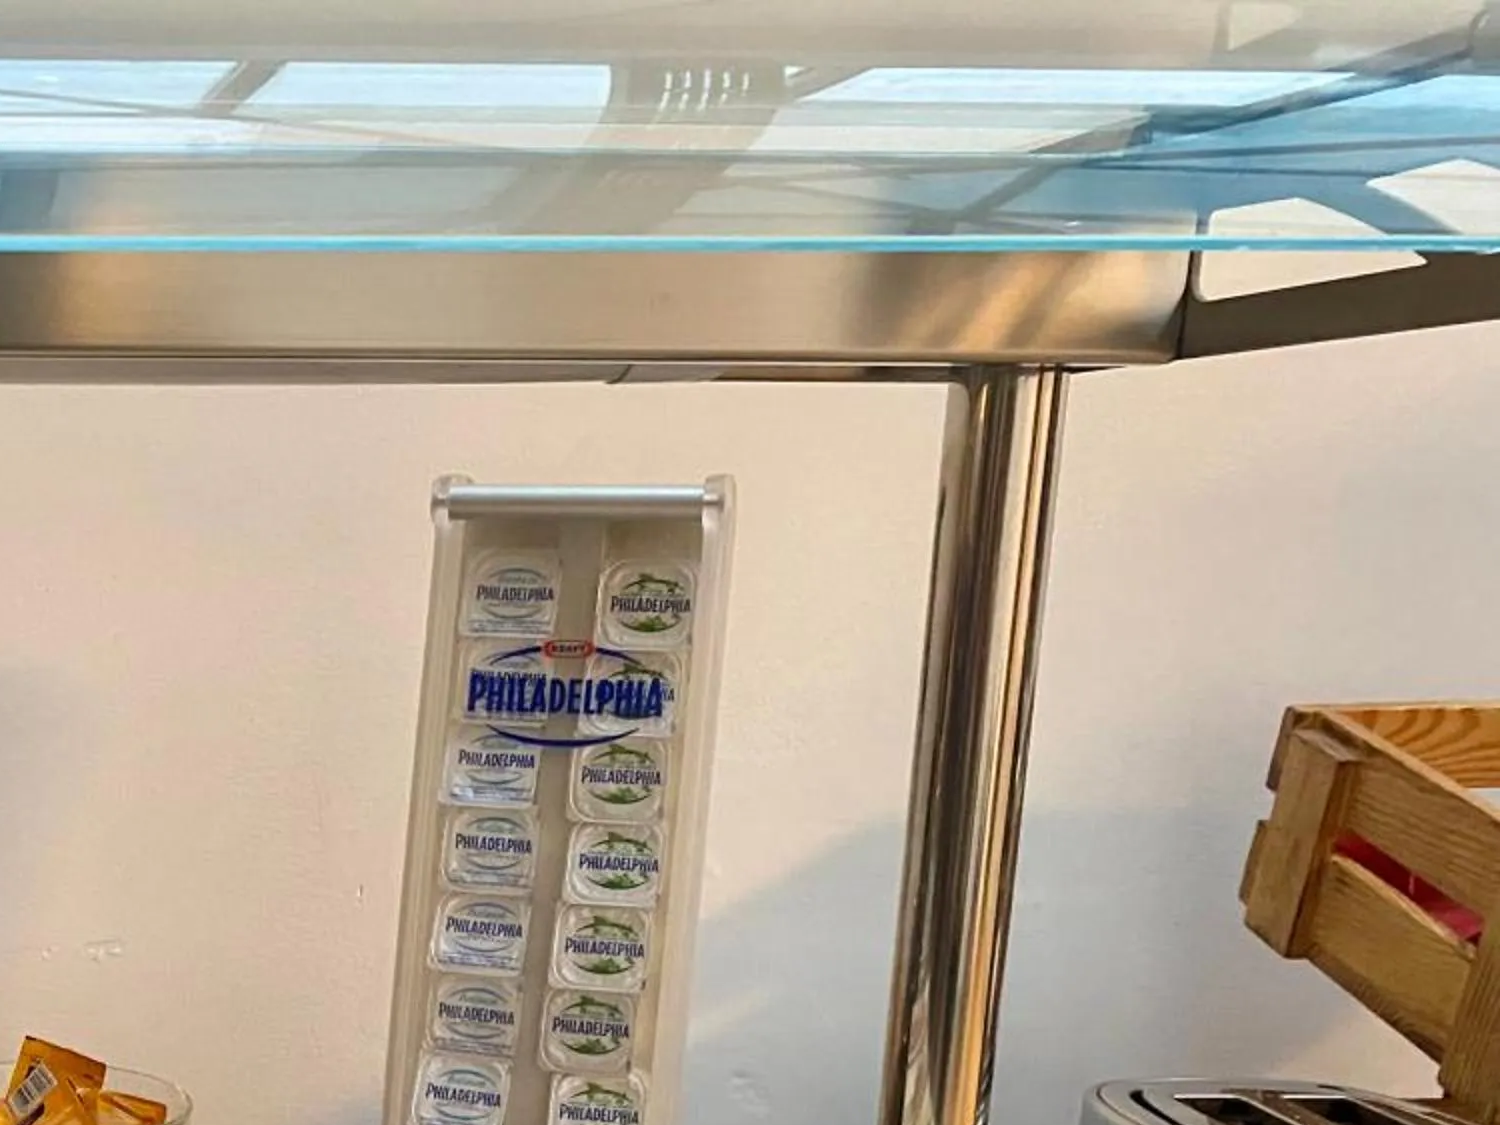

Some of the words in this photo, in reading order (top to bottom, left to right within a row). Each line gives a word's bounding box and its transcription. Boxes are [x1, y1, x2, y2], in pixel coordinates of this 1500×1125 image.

[476, 585, 555, 601] PHILADELPHIA
[610, 596, 691, 613] PHILADELPHIA
[467, 671, 662, 717] PHILADELPHIA
[458, 749, 535, 769] PHILADELPHIA
[581, 766, 661, 785] PHILADELPHIA
[455, 833, 532, 854] PHILADELPHIA
[579, 853, 659, 873] PHILADELPHIA
[445, 916, 522, 938] PHILADELPHIA
[565, 937, 645, 958] PHILADELPHIA
[439, 1002, 515, 1026] PHILADELPHIA
[552, 1016, 630, 1039] PHILADELPHIA
[425, 1082, 501, 1109] PHILADELPHIA
[559, 1103, 639, 1125] PHILADELPHIA
